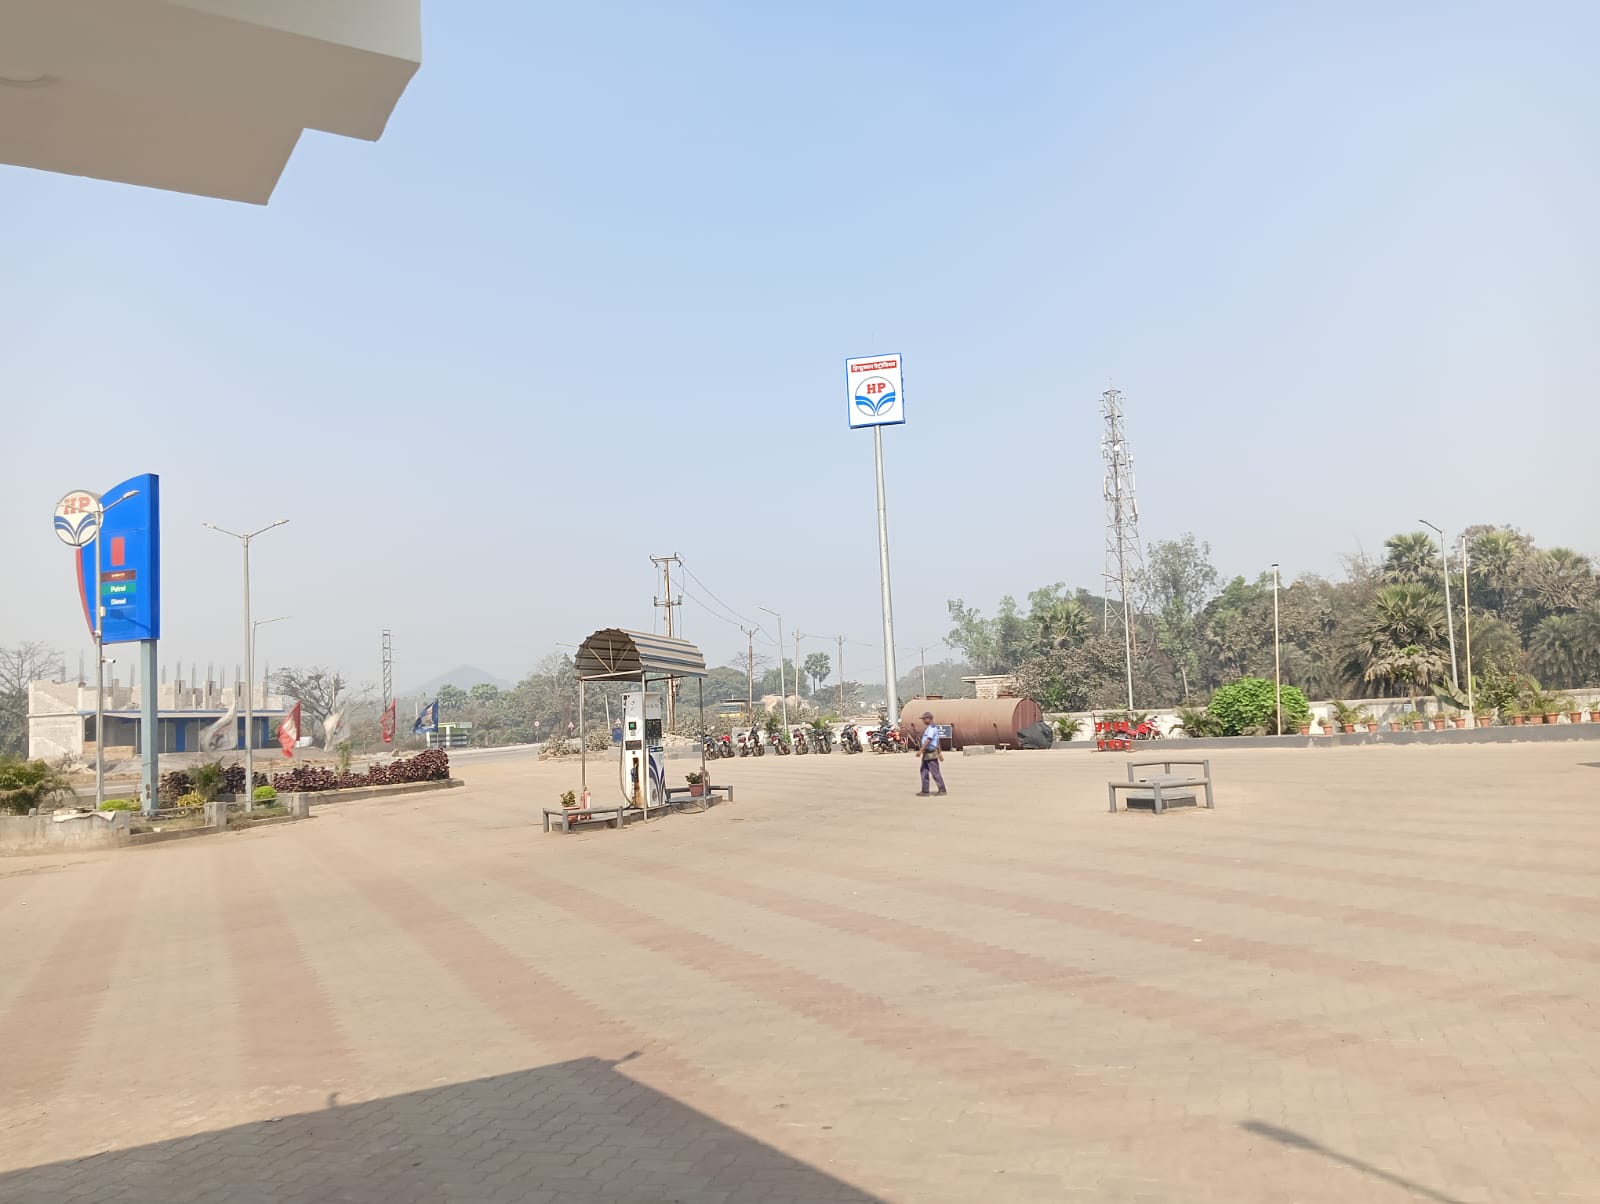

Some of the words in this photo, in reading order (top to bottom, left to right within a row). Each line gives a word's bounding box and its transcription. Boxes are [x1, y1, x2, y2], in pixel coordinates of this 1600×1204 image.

[866, 382, 886, 394] HP
[63, 496, 91, 515] HP
[110, 585, 126, 593] Petrol
